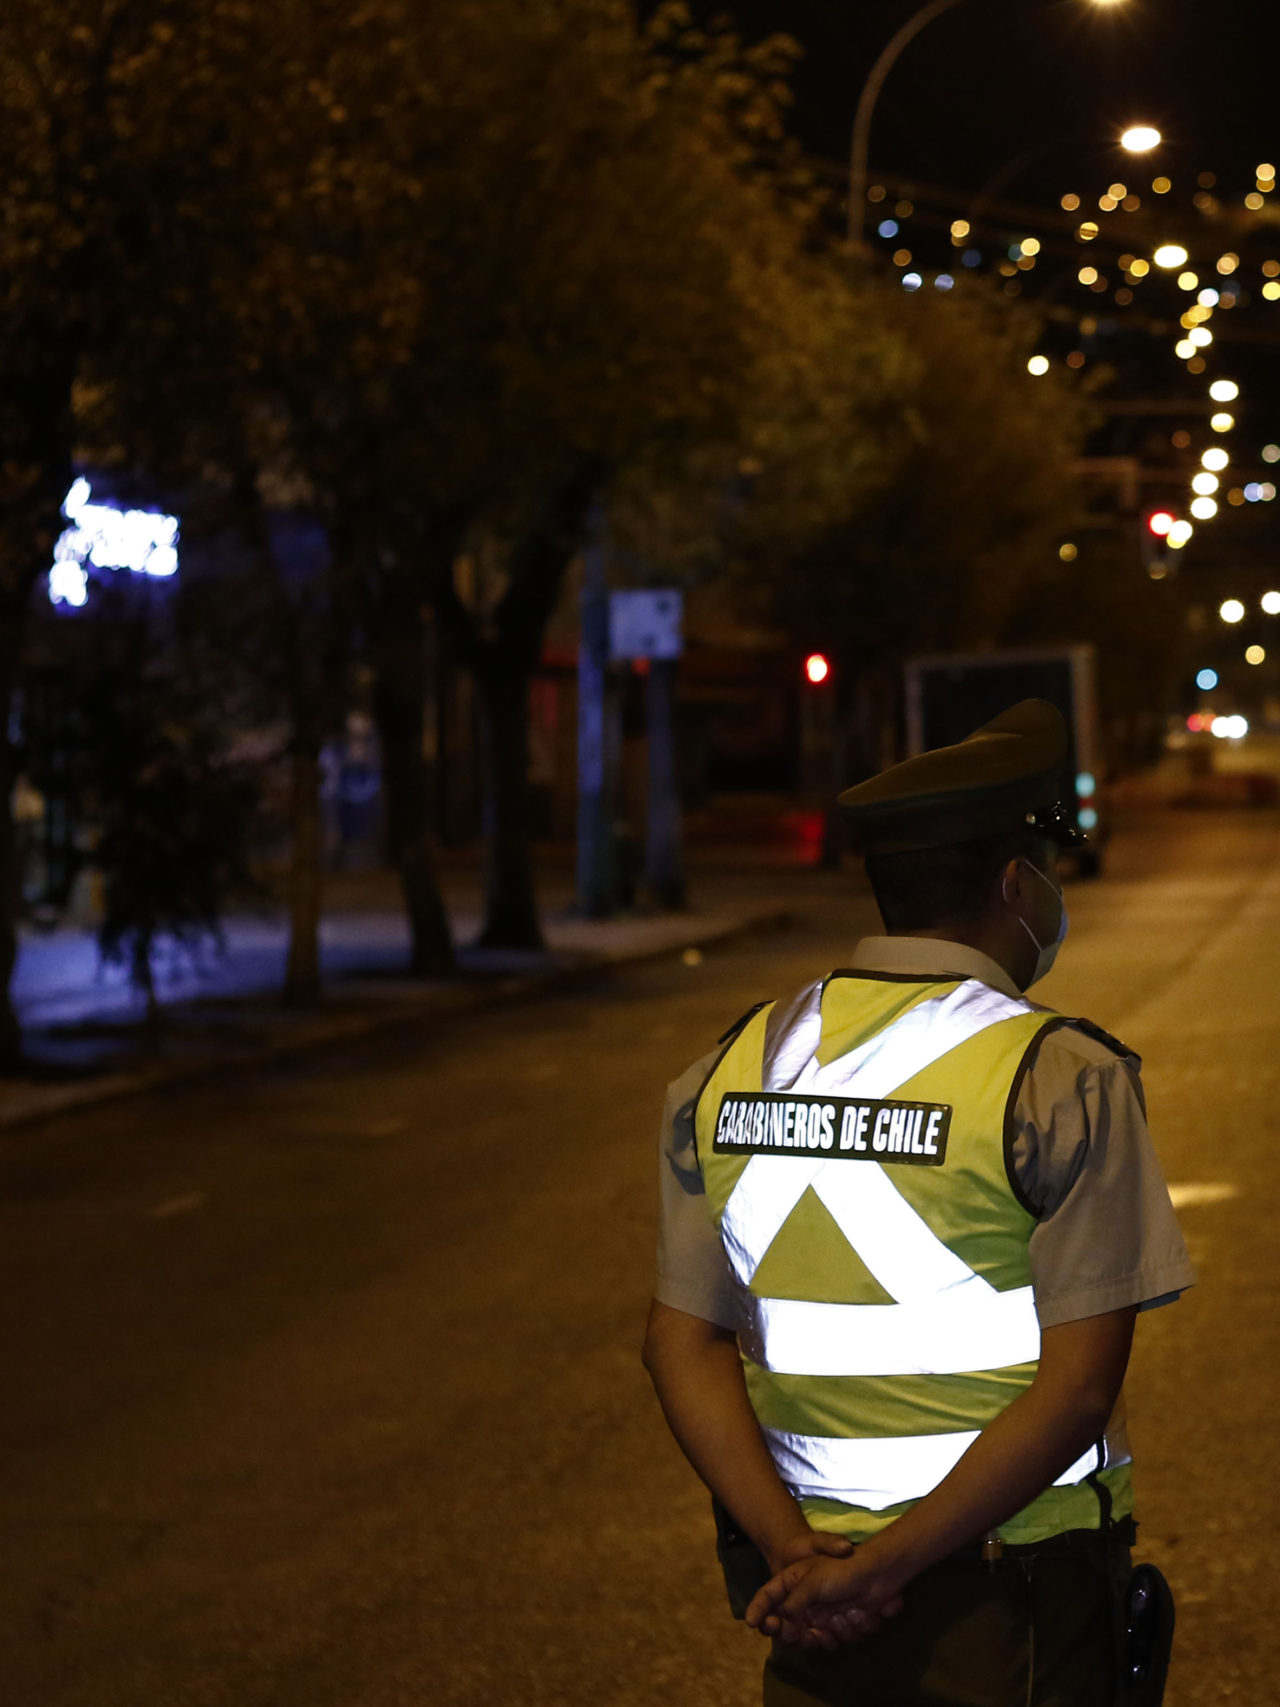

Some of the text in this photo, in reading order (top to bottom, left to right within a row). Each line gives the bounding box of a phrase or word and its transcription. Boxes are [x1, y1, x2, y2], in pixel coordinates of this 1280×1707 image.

[716, 1101, 943, 1154] CARABINEROS DE CHILE
